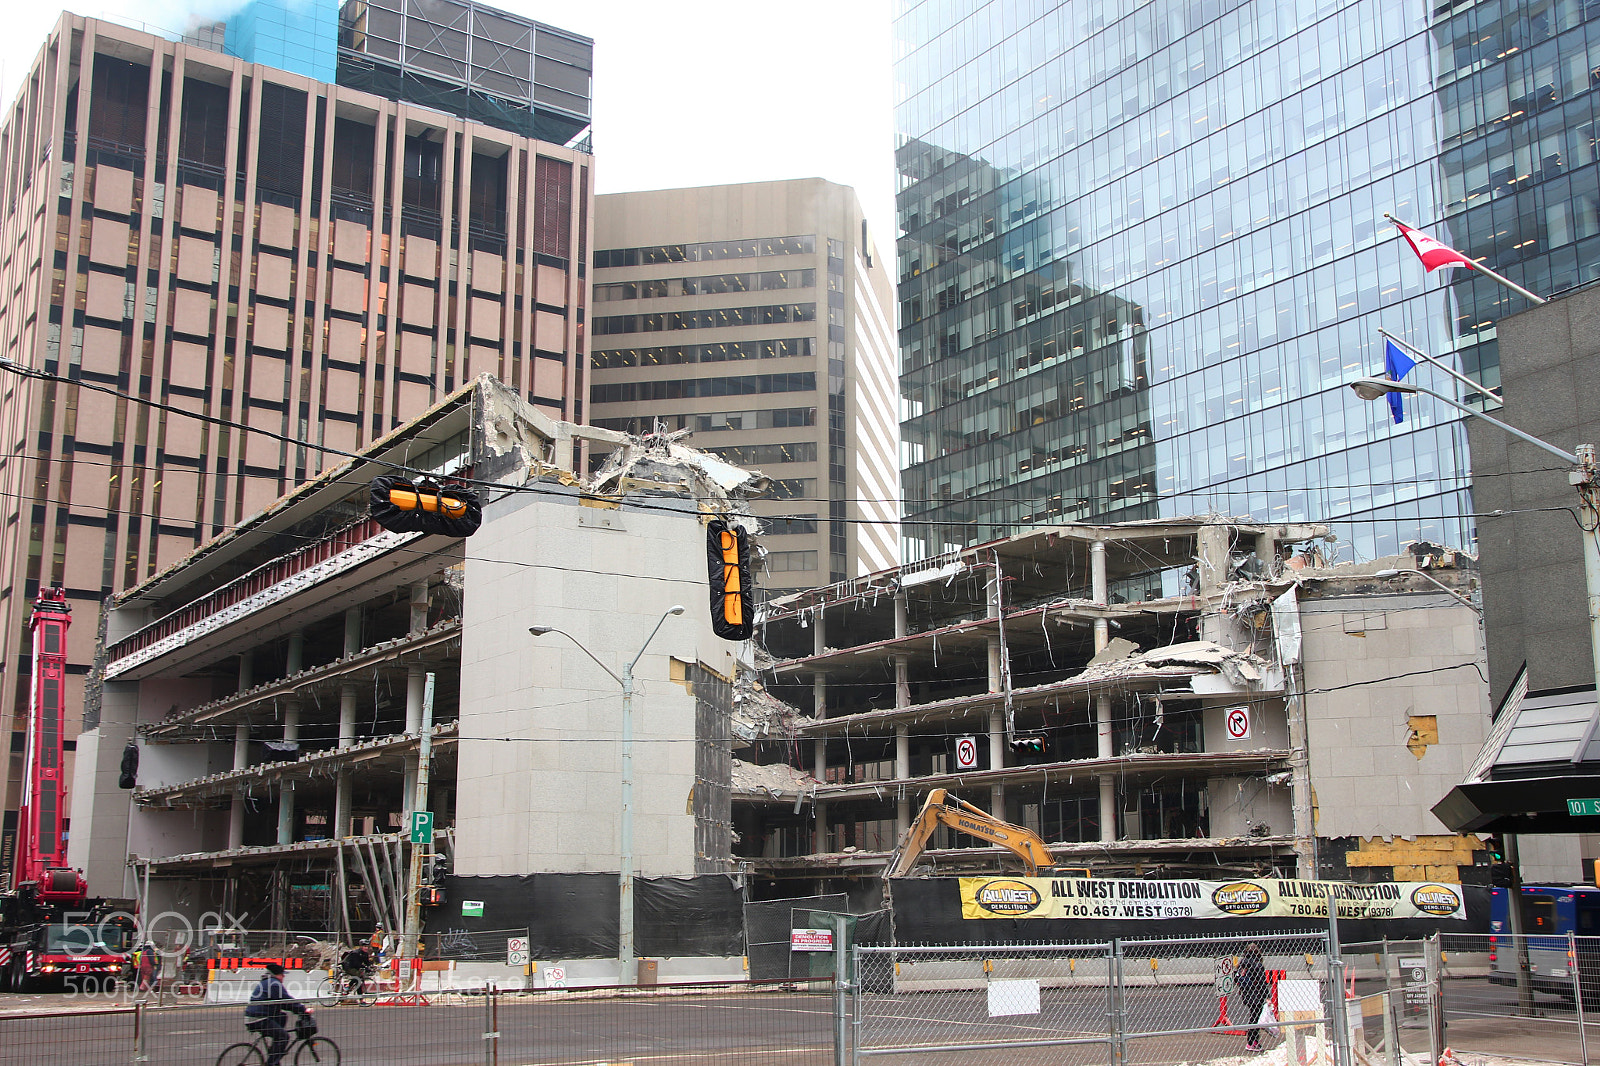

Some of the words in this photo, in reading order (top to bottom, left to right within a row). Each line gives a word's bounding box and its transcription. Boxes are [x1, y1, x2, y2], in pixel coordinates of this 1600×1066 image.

[1570, 801, 1587, 814] 101
[415, 813, 429, 831] P
[958, 818, 995, 836] KOMATSU
[1051, 880, 1075, 898] ALL
[1076, 881, 1115, 899] WEST
[1118, 881, 1202, 900] DEMOLITION
[1278, 881, 1298, 897] ALL
[1299, 882, 1330, 899] WEST
[1332, 884, 1402, 901] DEMOLITION
[1063, 904, 1163, 917] 780.467.WEST
[1164, 905, 1193, 918] (9378)
[1368, 906, 1394, 917] (9378)
[1423, 904, 1452, 912] DEMOLITION
